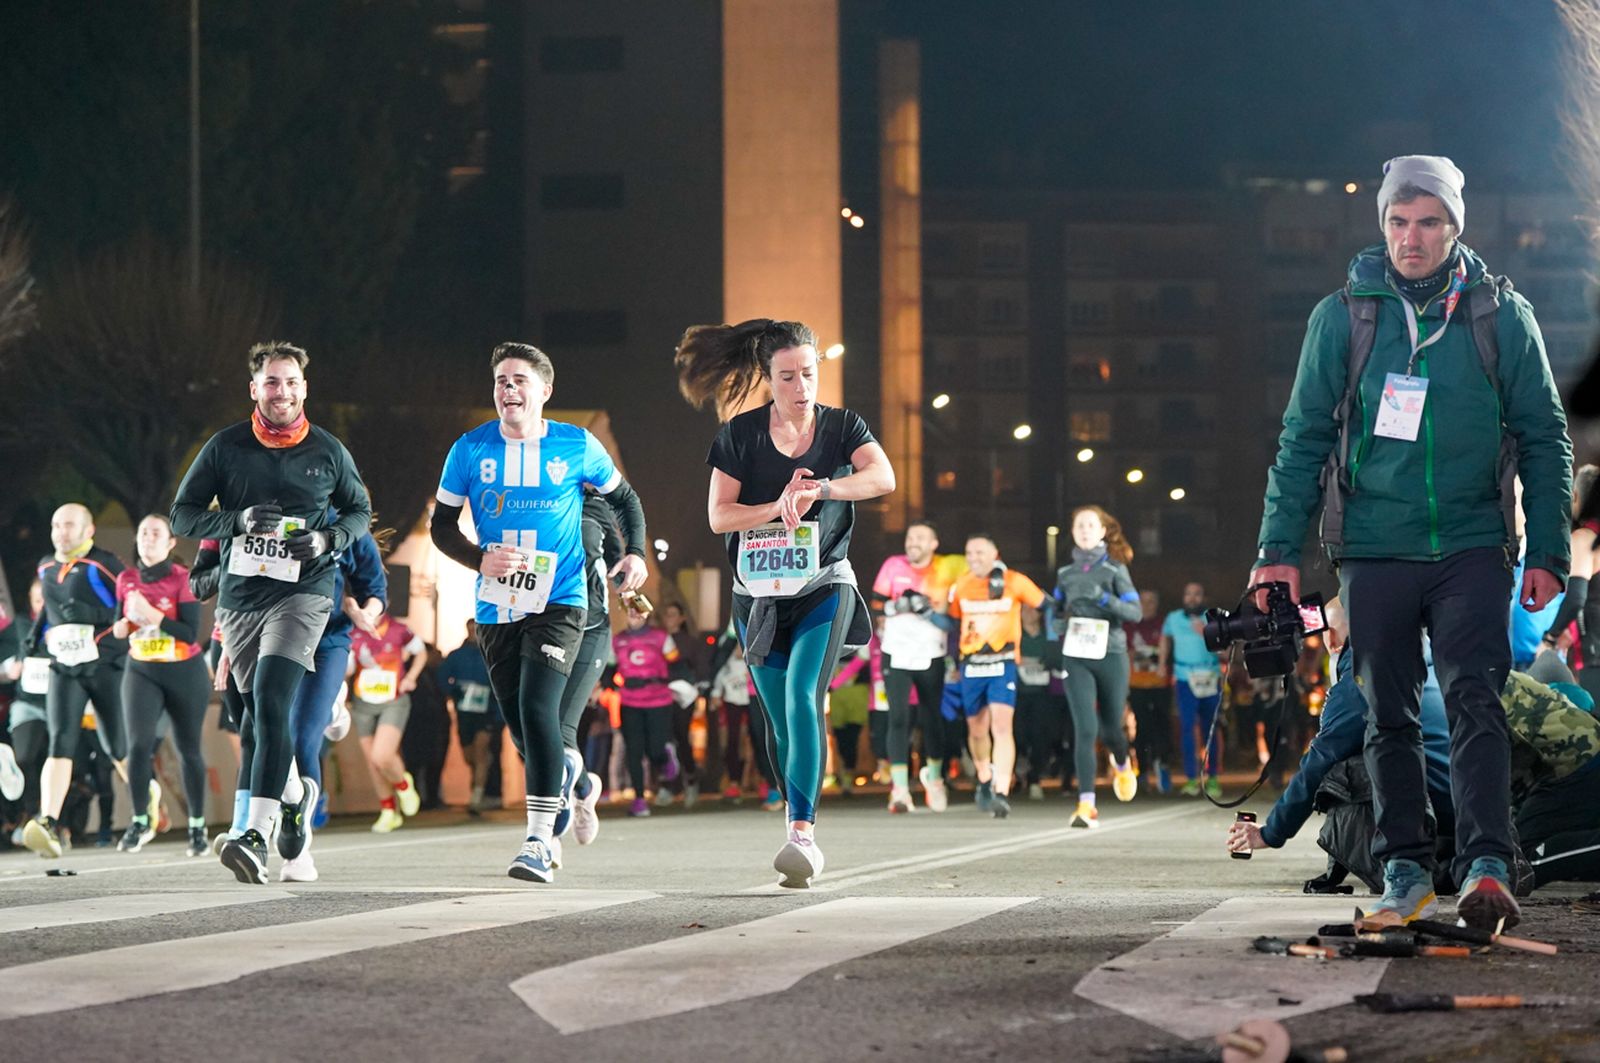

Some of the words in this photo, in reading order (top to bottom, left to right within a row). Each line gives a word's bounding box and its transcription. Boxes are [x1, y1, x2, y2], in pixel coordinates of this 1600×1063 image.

[480, 458, 497, 484] 8
[243, 534, 289, 559] 5363
[746, 541, 761, 550] SAN
[754, 531, 777, 540] NOCHE
[778, 530, 787, 538] DE
[747, 548, 808, 572] 12643
